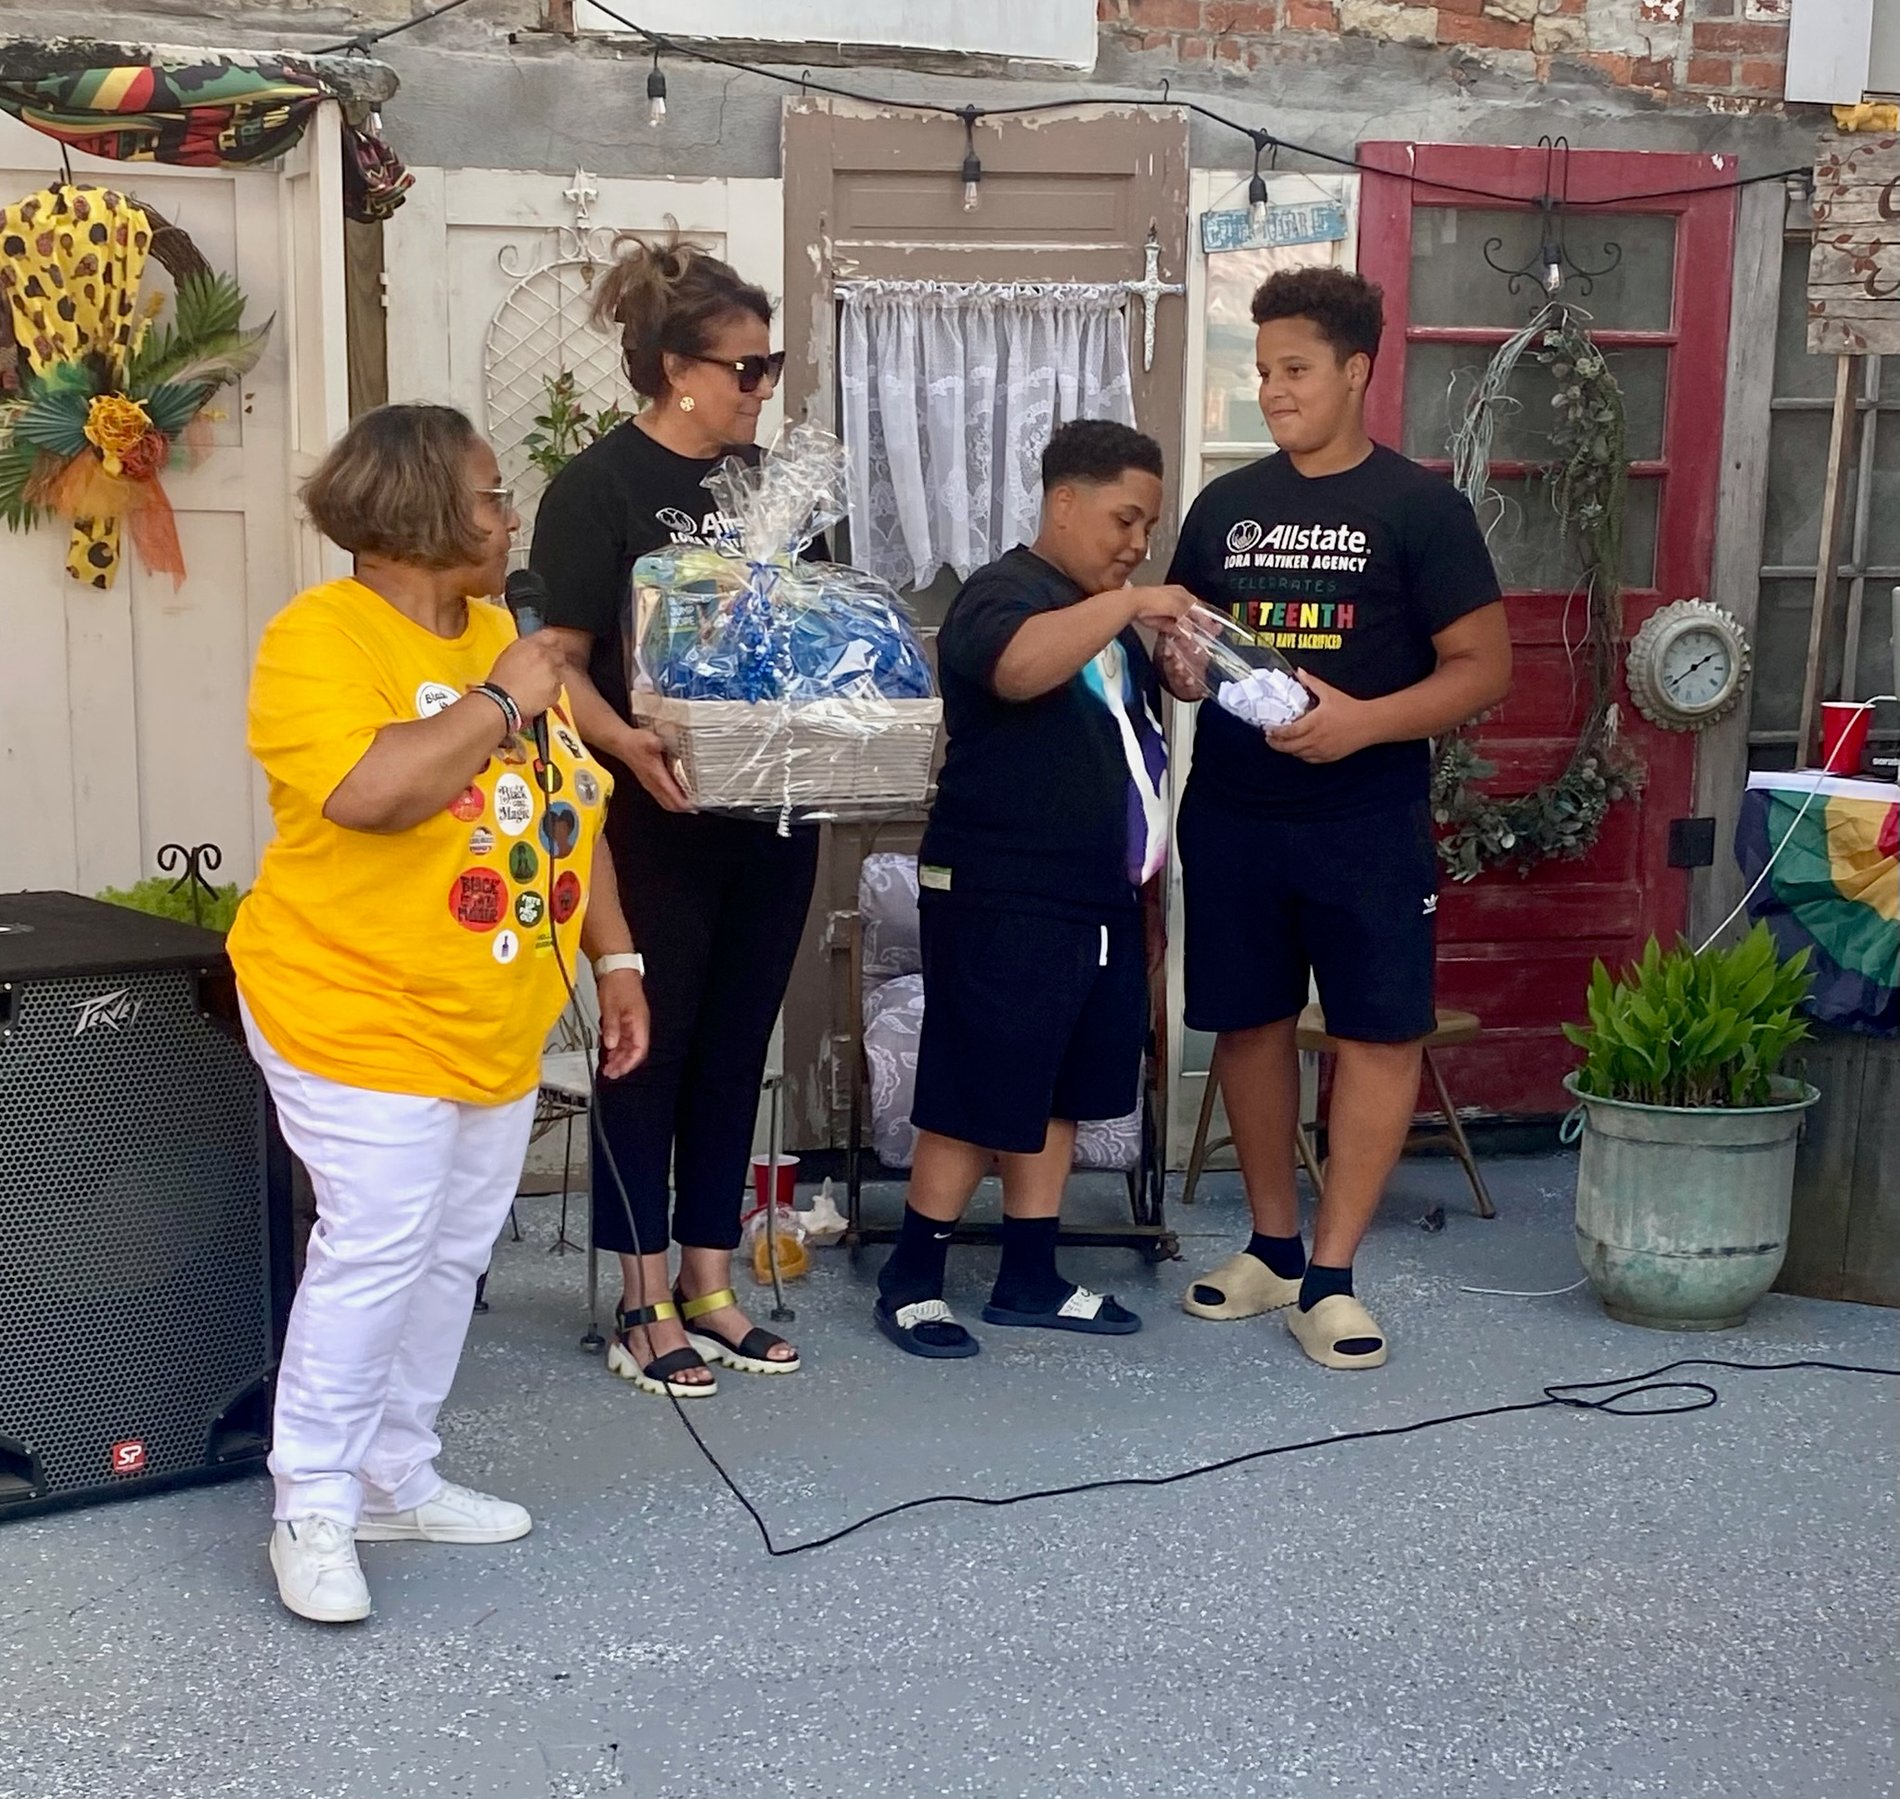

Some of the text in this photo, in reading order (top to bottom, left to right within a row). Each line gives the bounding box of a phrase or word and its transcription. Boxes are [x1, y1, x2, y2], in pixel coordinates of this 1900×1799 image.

[1311, 555, 1367, 572] AGENCY
[1276, 633, 1297, 649] HAVE
[68, 987, 144, 1037] PEAVEY
[118, 1445, 142, 1465] SP
